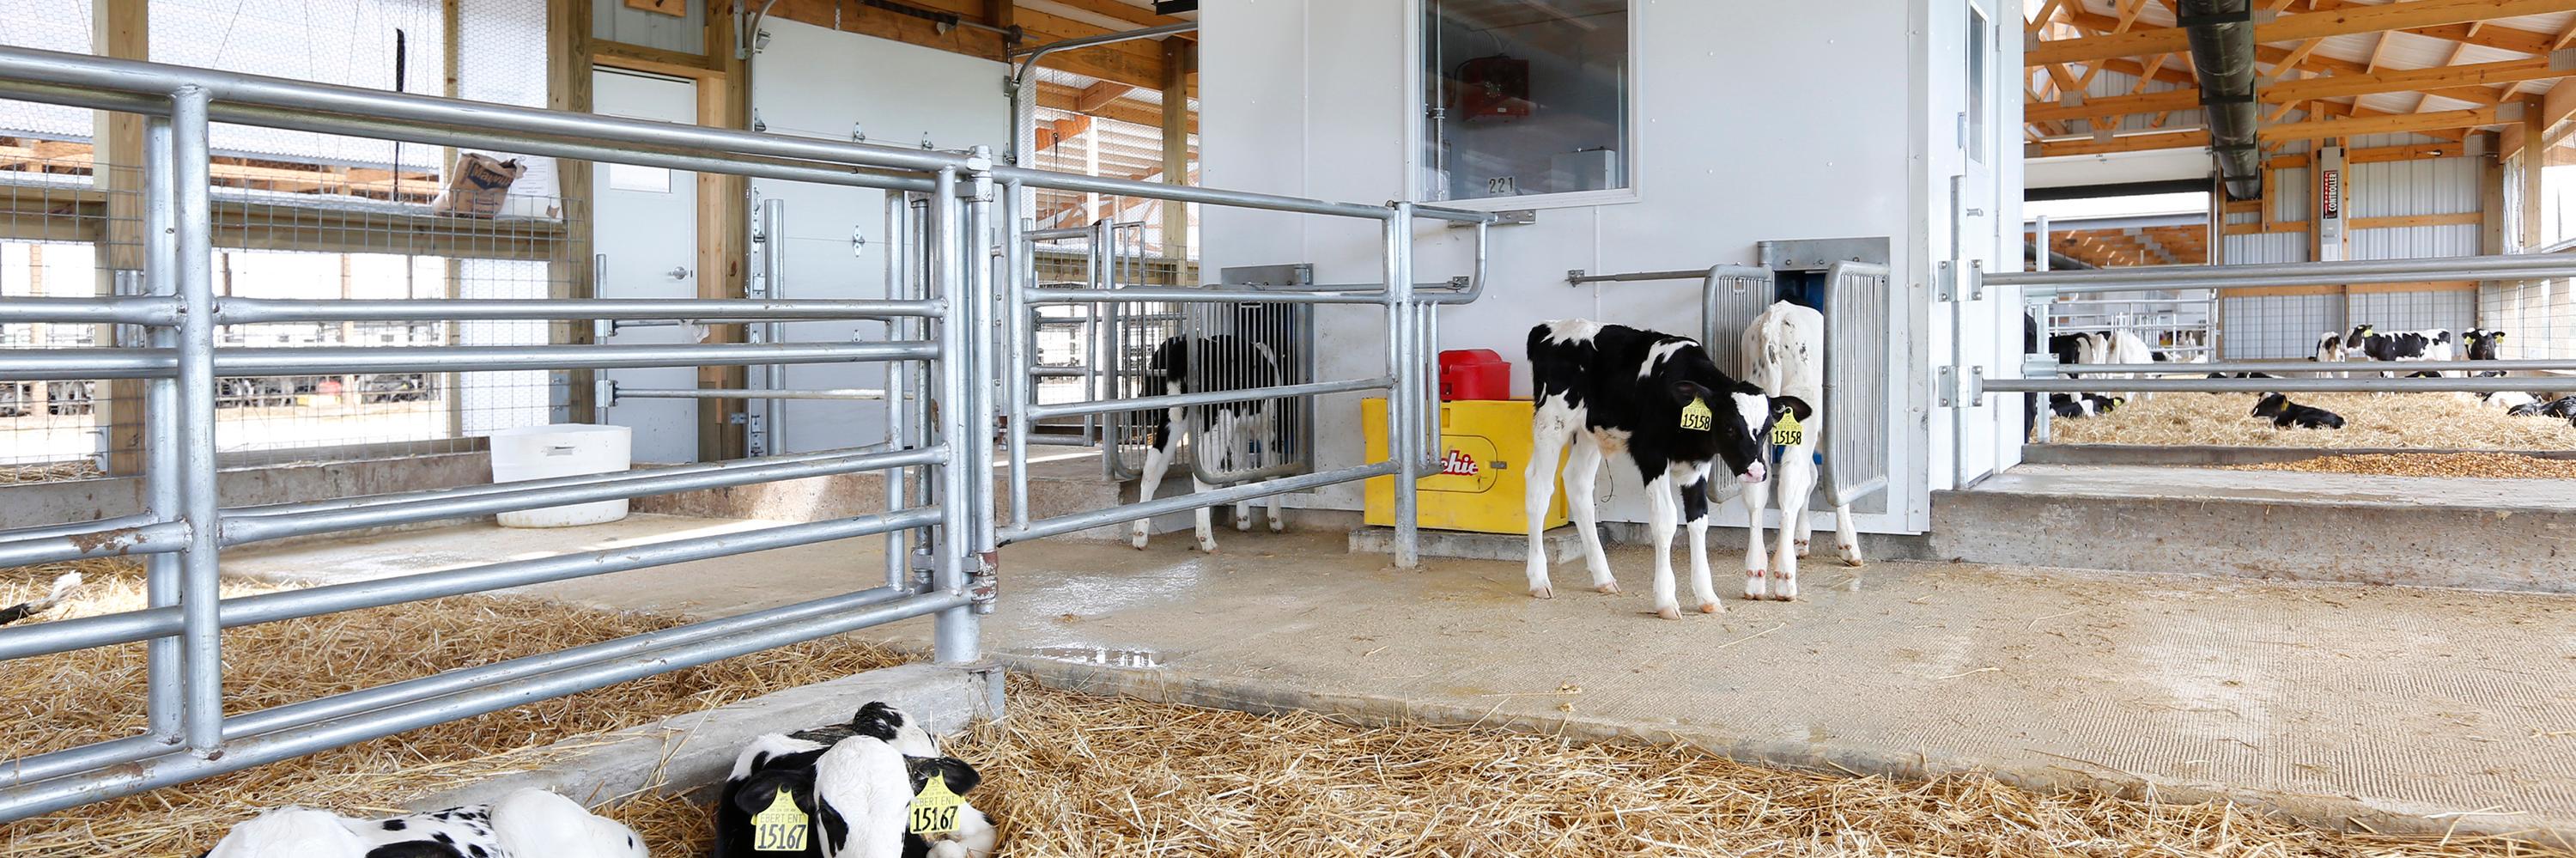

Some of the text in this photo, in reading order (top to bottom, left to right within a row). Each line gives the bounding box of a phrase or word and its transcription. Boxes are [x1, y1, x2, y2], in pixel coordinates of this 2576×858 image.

[1489, 177, 1513, 193] 221
[1682, 414, 1710, 429] 15158
[1774, 430, 1801, 445] 15158
[915, 795, 956, 807] EBERT ENT
[760, 813, 803, 824] EBERT ENT
[913, 806, 958, 831] 15167
[757, 824, 806, 849] 15167
